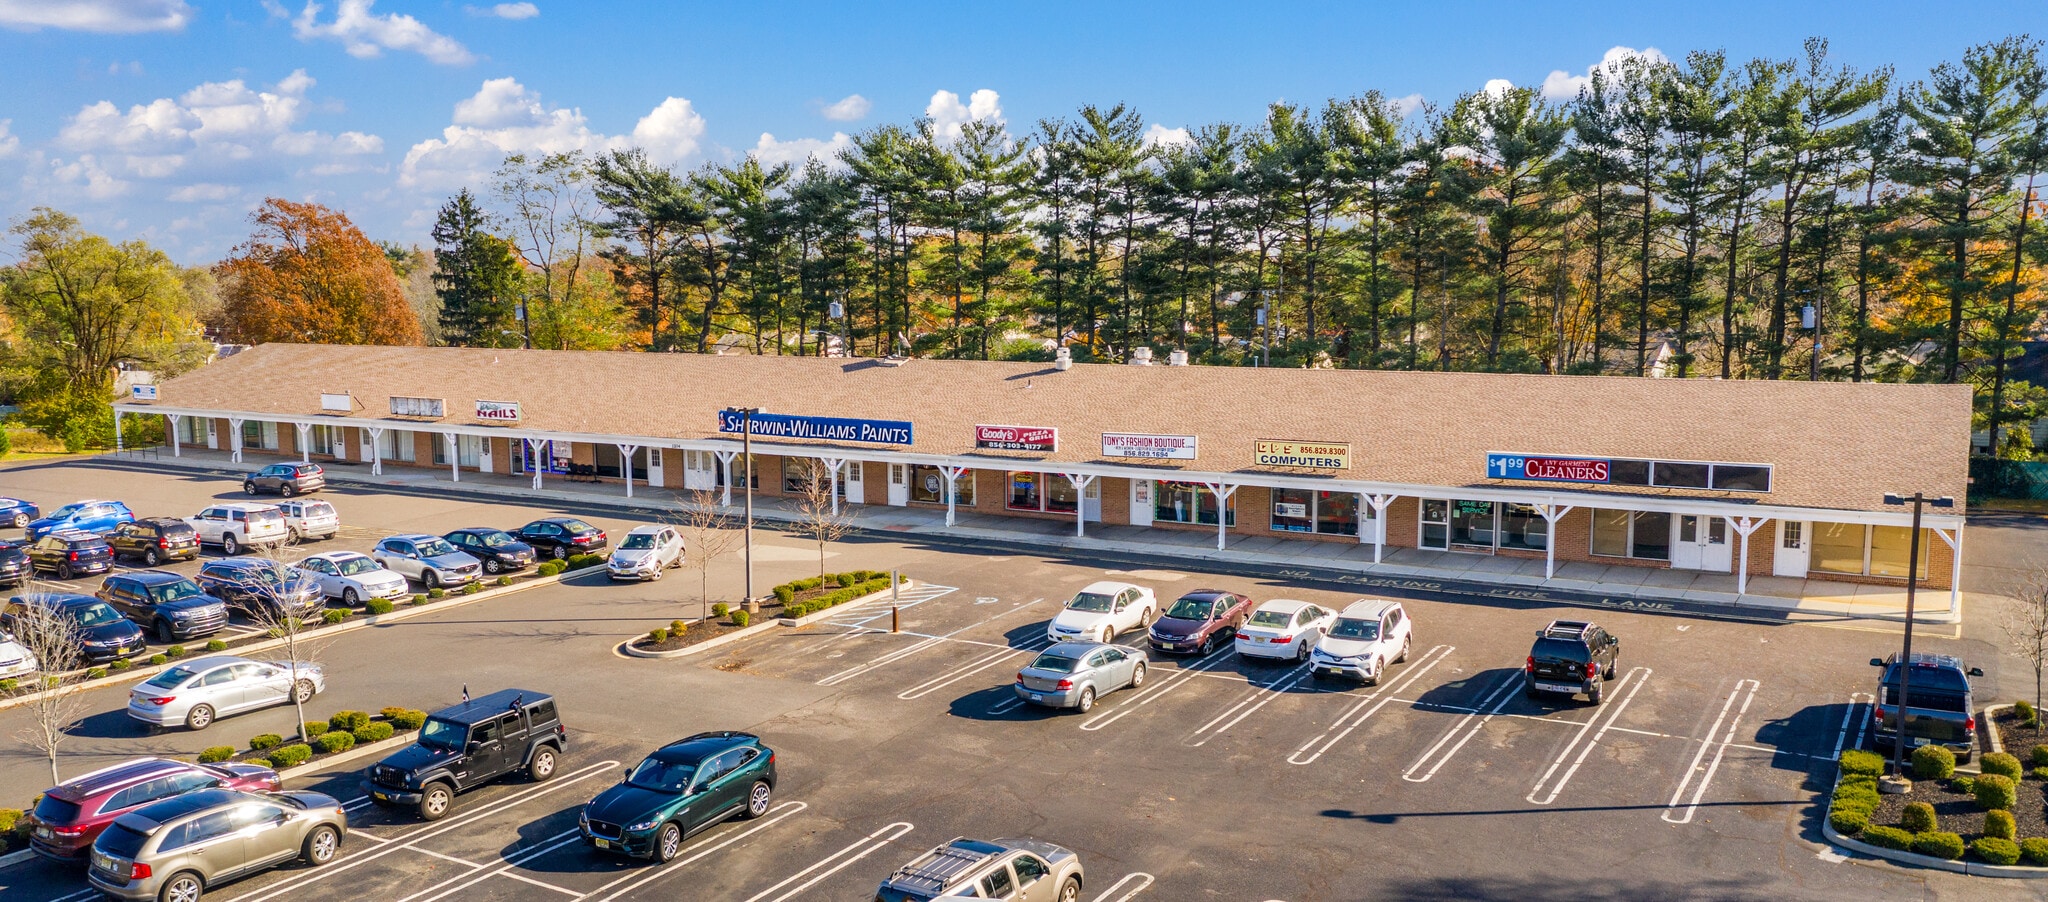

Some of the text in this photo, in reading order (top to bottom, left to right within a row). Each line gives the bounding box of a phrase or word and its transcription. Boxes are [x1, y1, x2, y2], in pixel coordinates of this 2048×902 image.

[476, 409, 517, 419] NAILS
[726, 415, 909, 443] SHRWIN-WILLIAMS PAINTS
[982, 428, 1013, 441] Goody's
[1023, 430, 1049, 438] PIZZA
[1029, 434, 1054, 442] GRILL
[1103, 436, 1186, 448] TONY'S FASHION BOUTIQUE
[1300, 446, 1346, 456] 856.829.8300
[1260, 455, 1342, 468] COMPUTERS
[1558, 460, 1592, 468] GARMENT
[1525, 459, 1608, 480] CLEANERS
[1279, 569, 1675, 611] NO PARKING FIRE LANE
